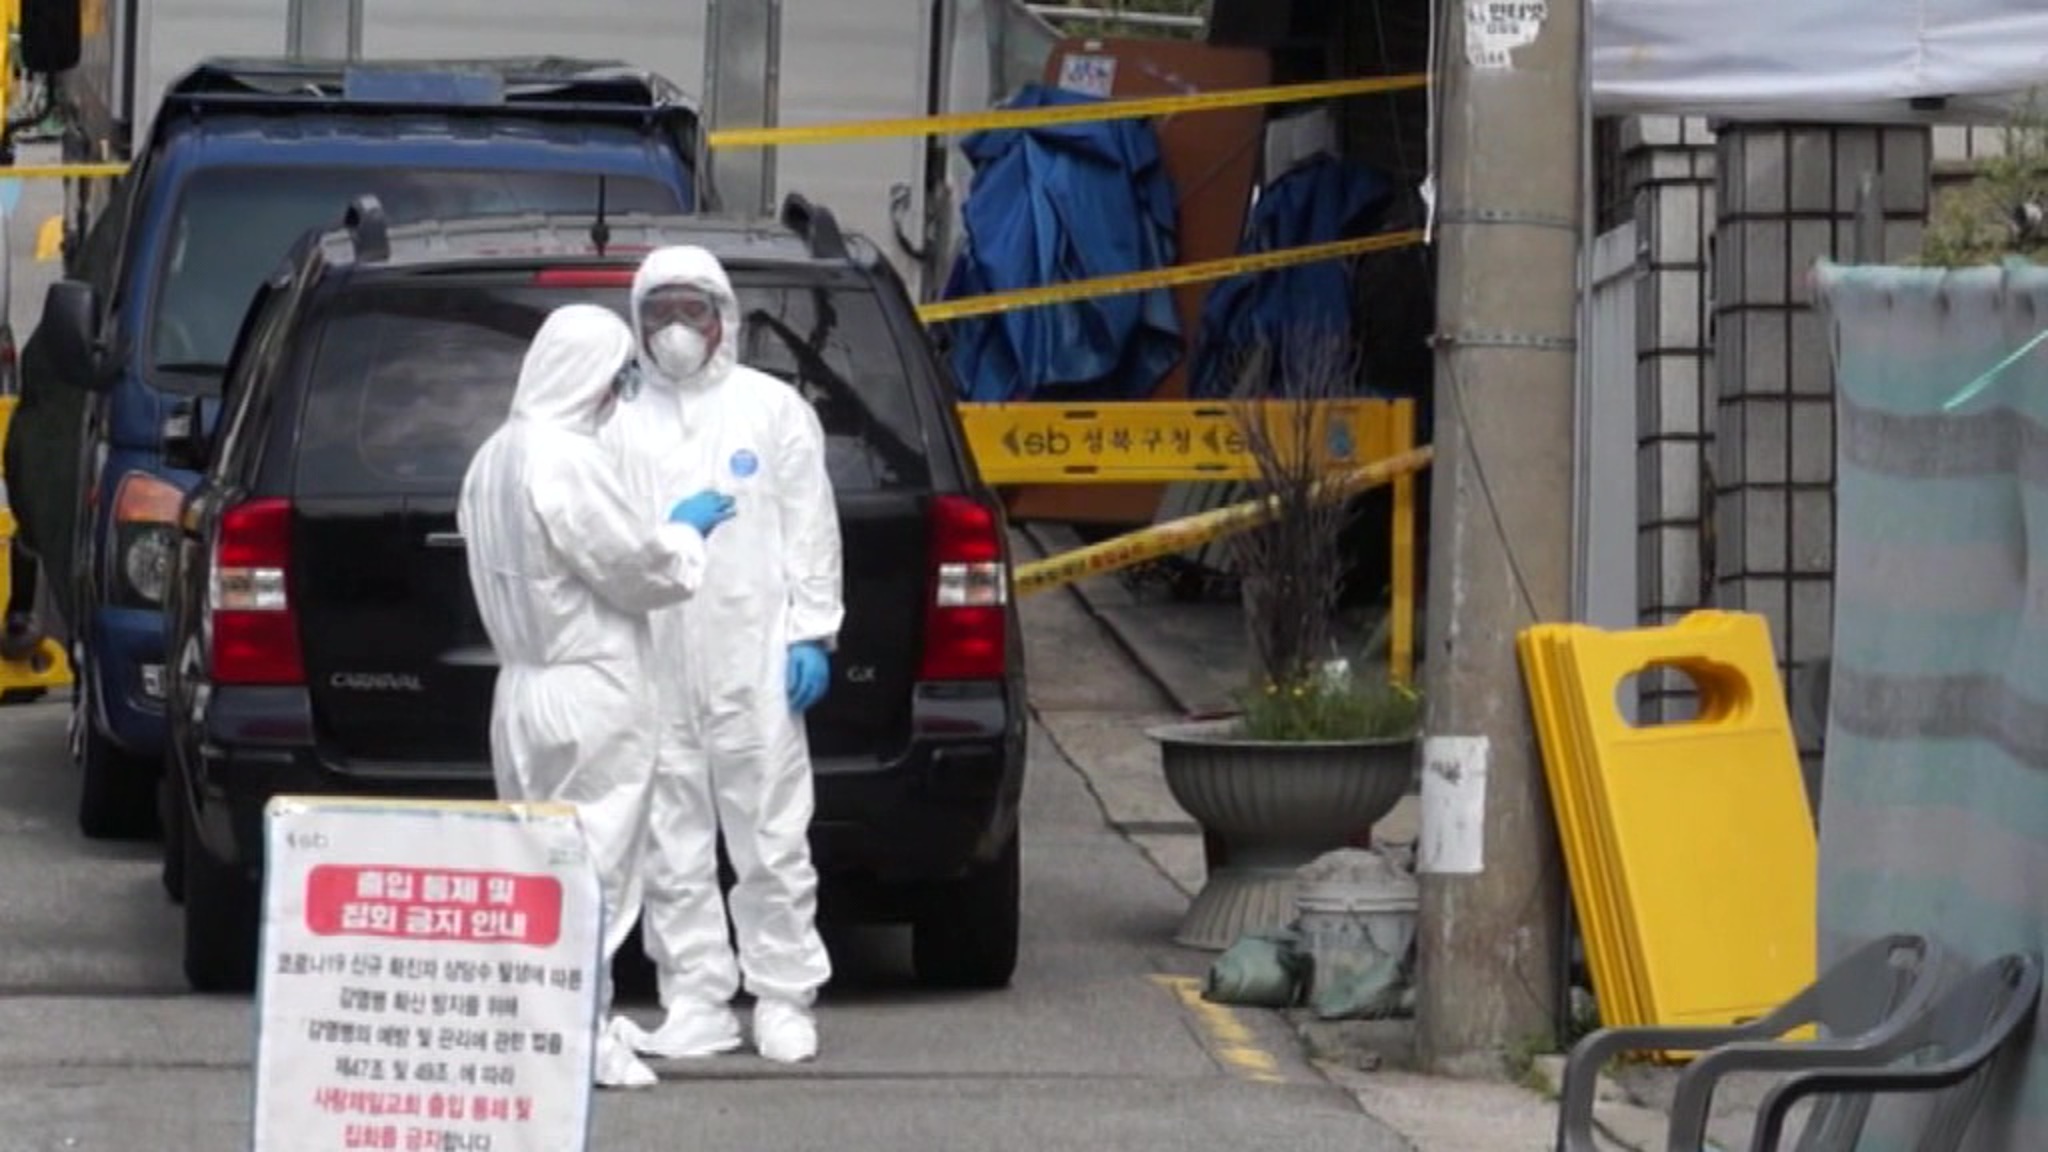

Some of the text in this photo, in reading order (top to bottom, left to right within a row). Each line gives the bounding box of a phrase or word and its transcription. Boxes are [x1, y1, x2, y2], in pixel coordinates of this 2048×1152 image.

[1024, 427, 1071, 455] sb
[1083, 427, 1191, 454] 성북구청
[329, 671, 423, 690] CARNIVAL
[356, 870, 515, 906] 출입 통제 및
[342, 902, 527, 938] 집회 금지 안내
[278, 952, 583, 992] 코로나19 신규 확진자 상당수 발생에 따른
[340, 986, 386, 1012] 감염병
[393, 989, 427, 1015] 확산
[431, 991, 479, 1017] 방지를
[308, 1019, 371, 1043] 감염병의
[377, 1024, 411, 1048] 예방
[416, 1027, 433, 1048] 및
[438, 1027, 487, 1051] 관리에
[494, 1030, 526, 1053] 관한
[393, 1060, 409, 1081] 및
[460, 1063, 475, 1085] 에
[481, 1063, 515, 1085] 따라
[314, 1086, 533, 1121] 사랑제일교회 출입 통제 및
